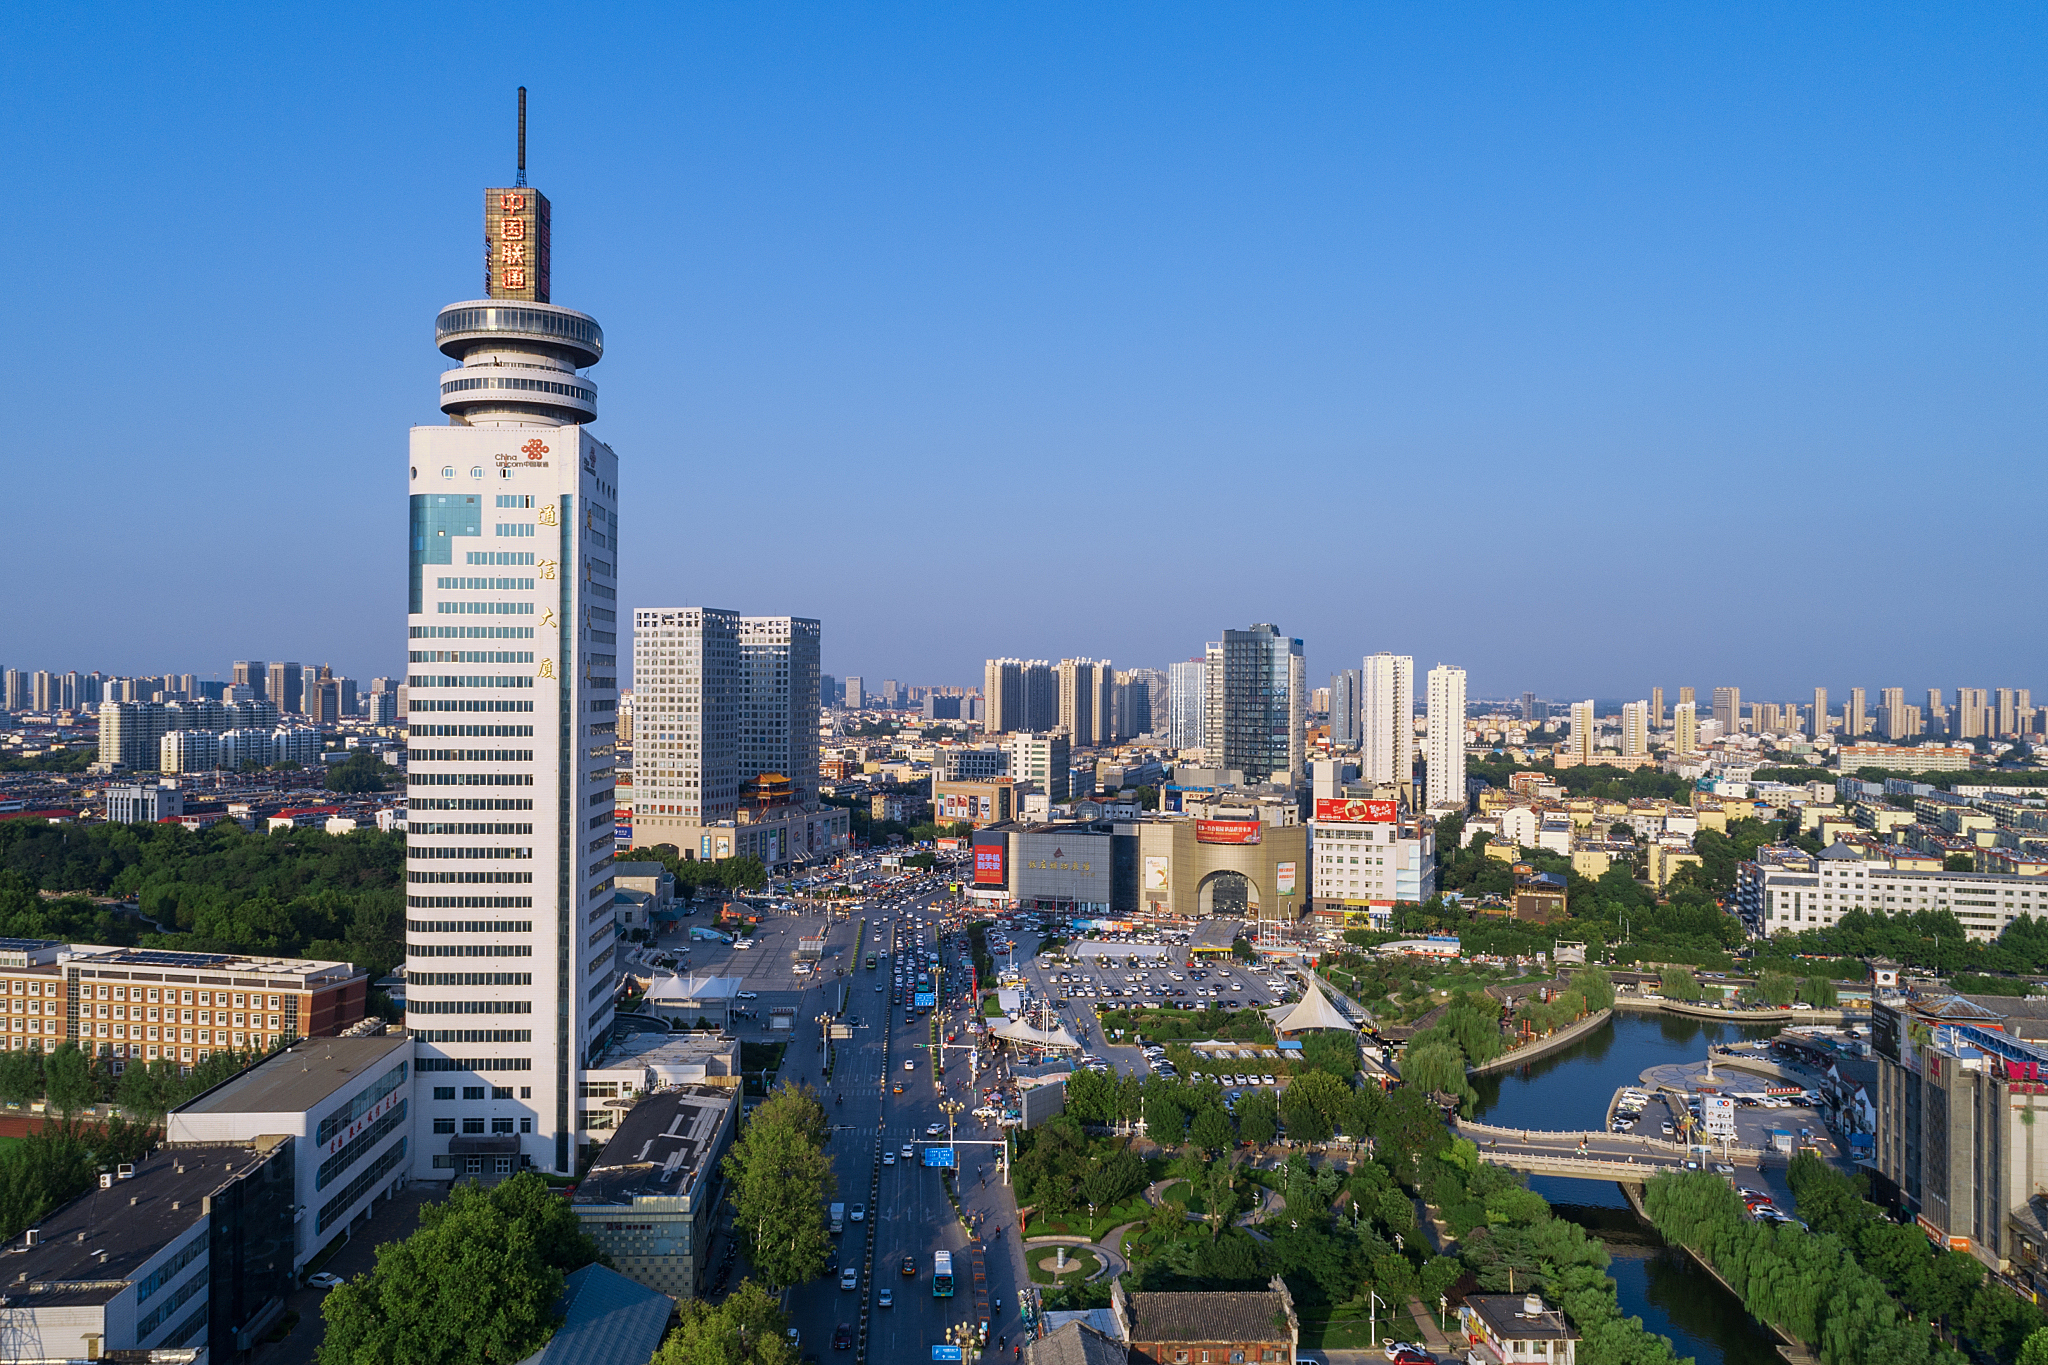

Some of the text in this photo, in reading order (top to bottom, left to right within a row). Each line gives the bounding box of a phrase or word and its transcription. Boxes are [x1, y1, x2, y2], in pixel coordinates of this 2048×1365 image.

[500, 192, 525, 289] 中国联通
[537, 504, 558, 680] 通信大厦
[977, 853, 1000, 862] 买手机
[977, 862, 1000, 870] 到天安
